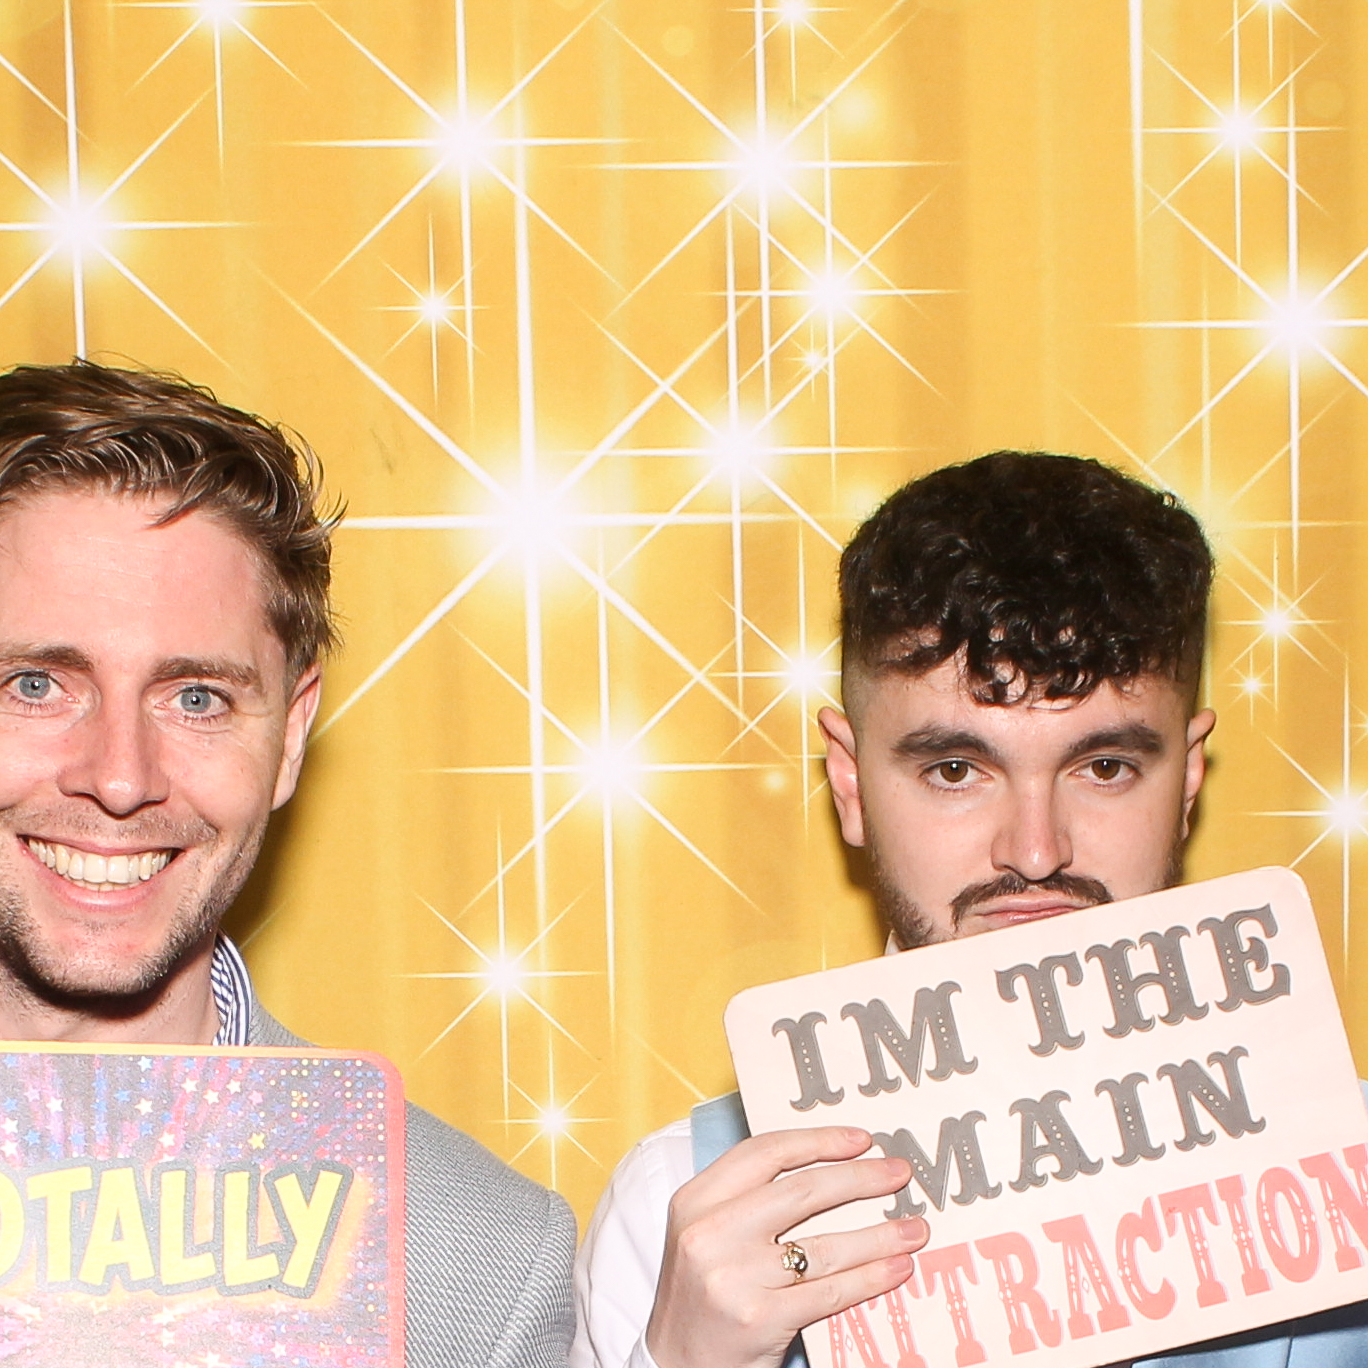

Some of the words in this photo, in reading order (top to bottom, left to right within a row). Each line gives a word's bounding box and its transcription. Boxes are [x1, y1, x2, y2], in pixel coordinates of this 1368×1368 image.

[772, 981, 978, 1111] IM
[995, 904, 1291, 1057] THE
[872, 1046, 1266, 1221] MAIN
